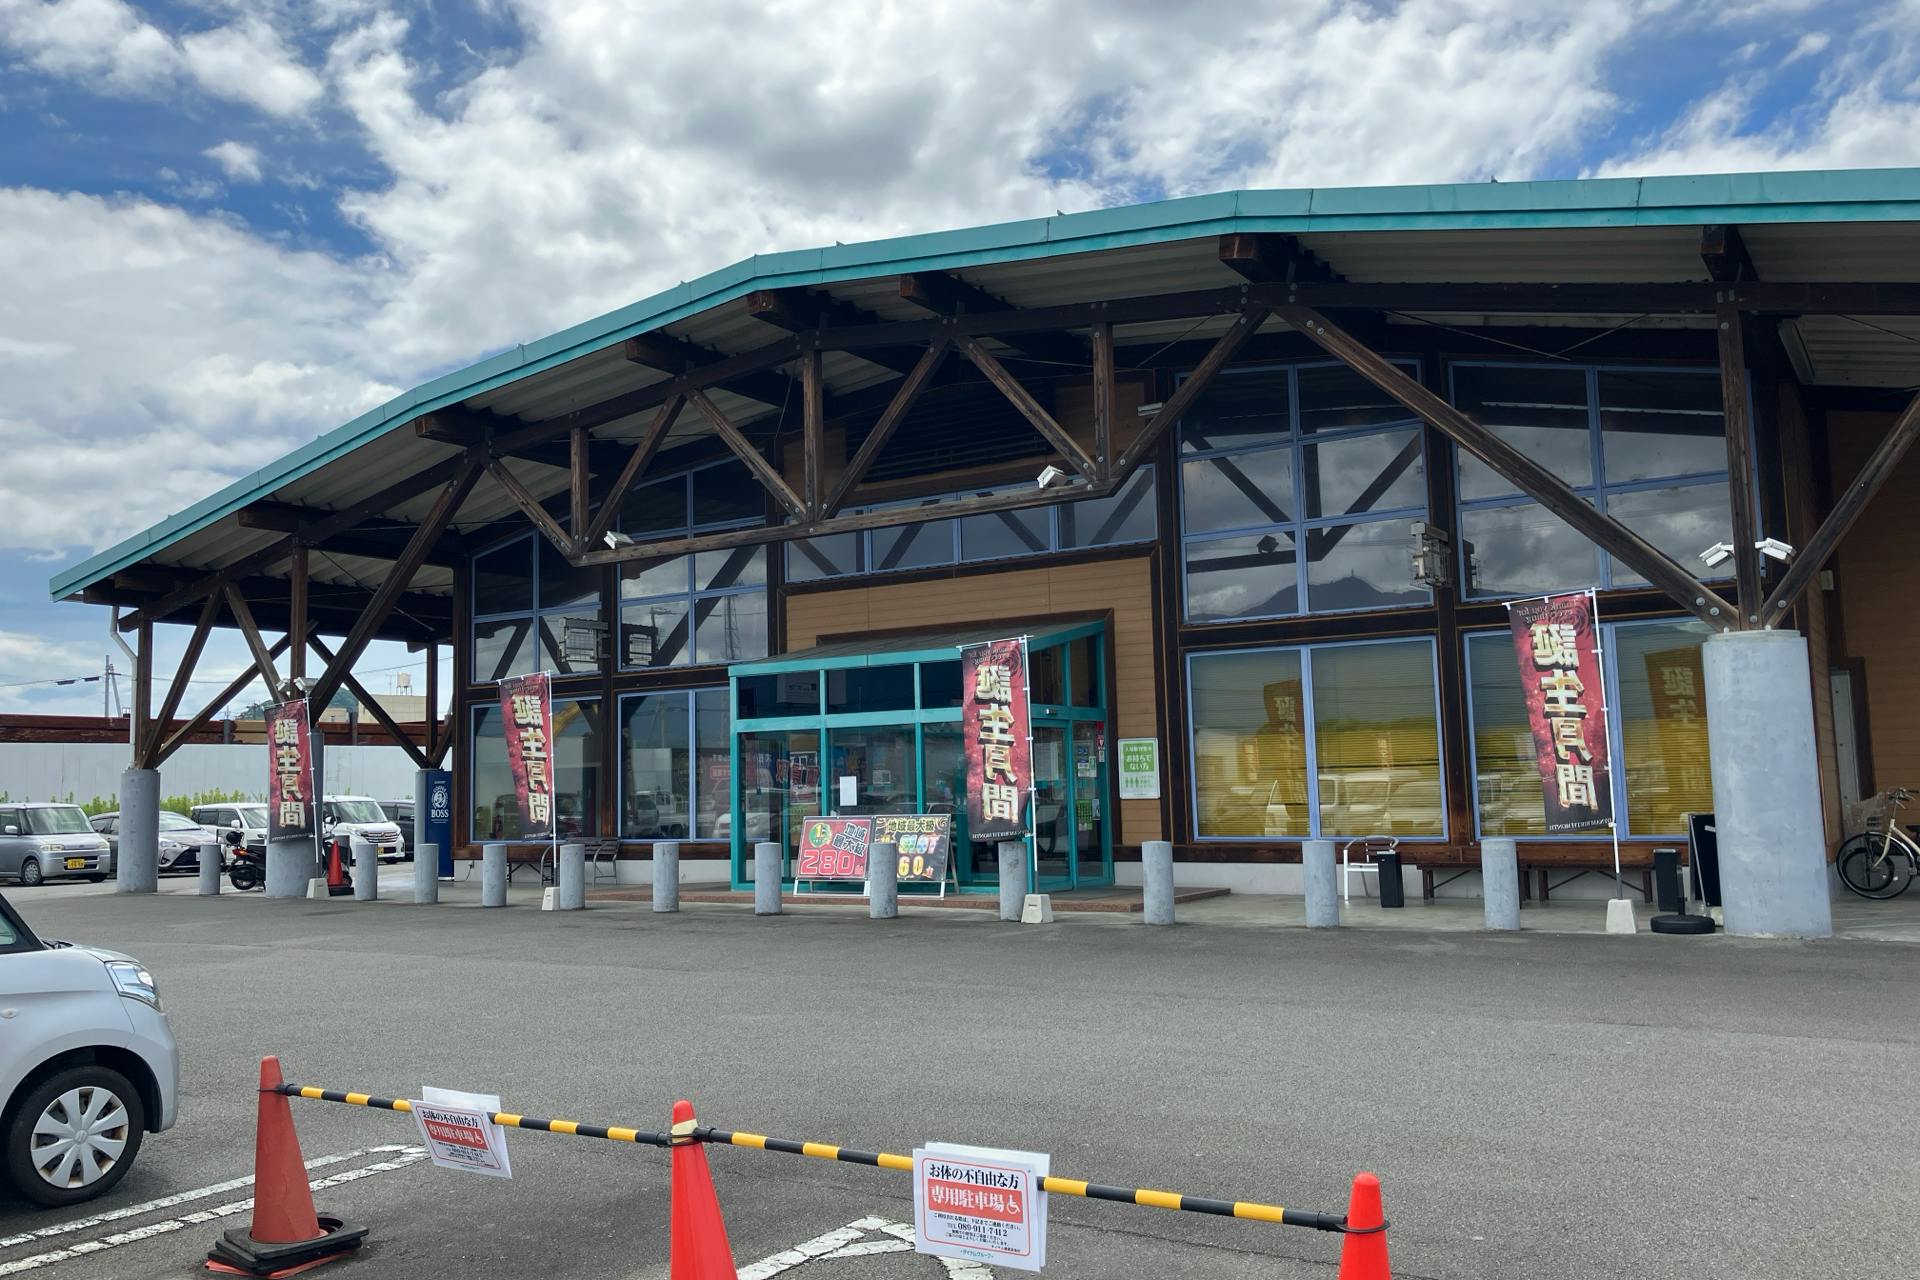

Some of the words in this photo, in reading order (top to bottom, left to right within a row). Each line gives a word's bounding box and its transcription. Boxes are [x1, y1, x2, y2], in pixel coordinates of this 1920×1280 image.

[431, 810, 449, 818] BOSS
[898, 834, 940, 854] SLOT
[929, 1163, 1019, 1190] お体の不自由な方
[930, 1185, 1005, 1213] 専用駐車場
